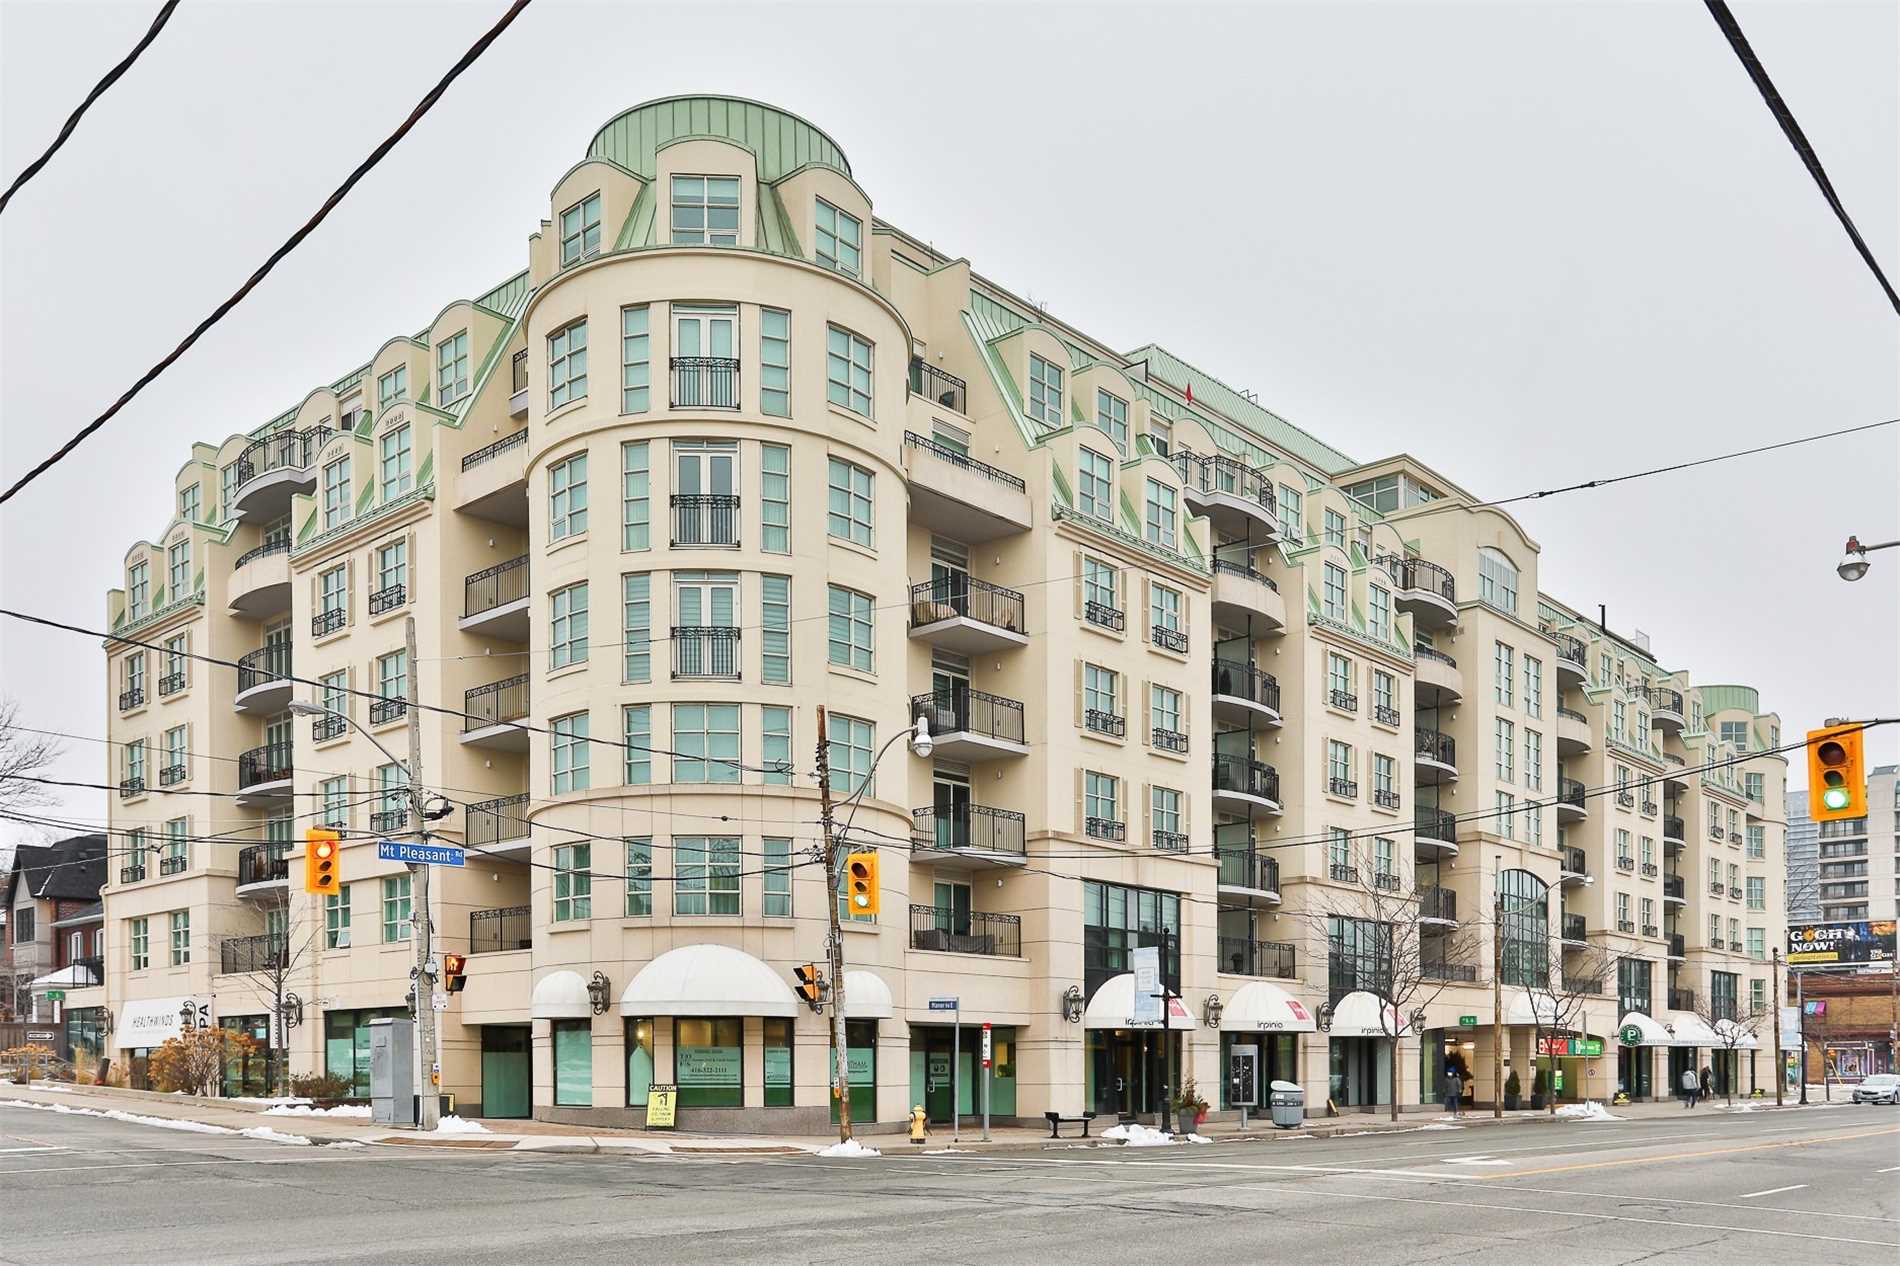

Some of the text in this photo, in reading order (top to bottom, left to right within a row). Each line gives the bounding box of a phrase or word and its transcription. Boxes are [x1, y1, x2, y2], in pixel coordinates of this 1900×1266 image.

[380, 844, 463, 863] Mt Pleasant Rd
[1791, 941, 1834, 952] NOW!
[132, 1014, 175, 1028] HEALTHWINDS
[1627, 1029, 1637, 1041] P
[649, 1084, 677, 1092] CAUTION
